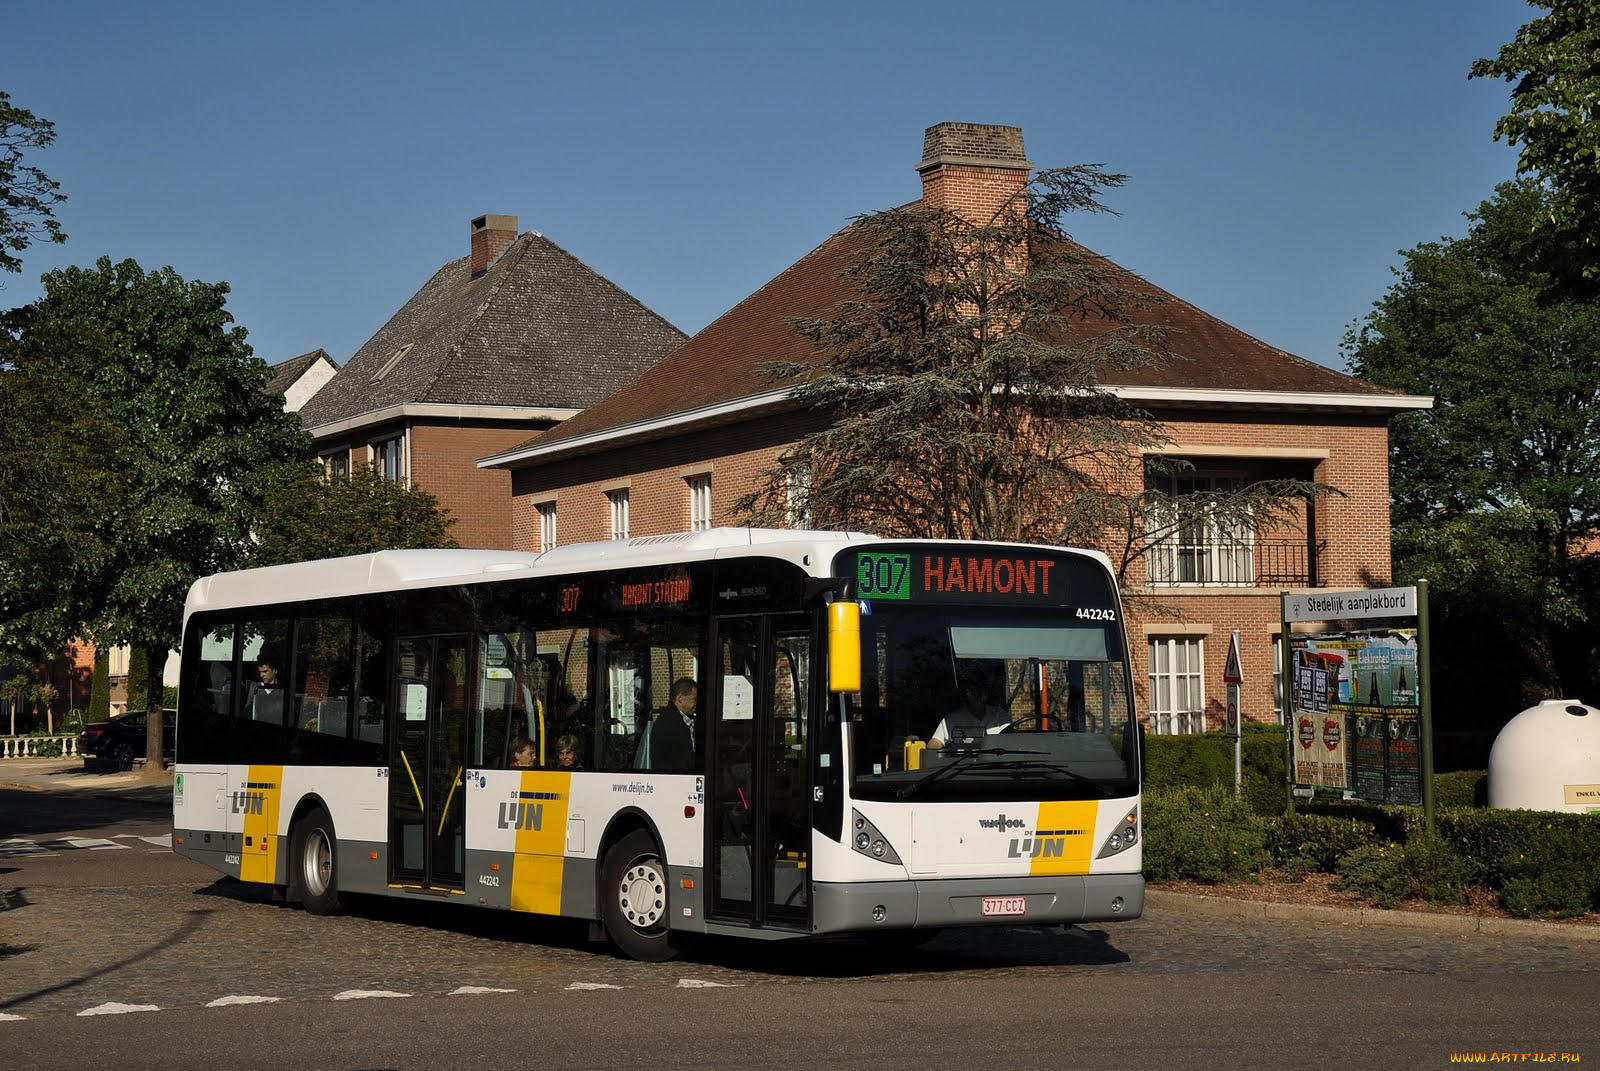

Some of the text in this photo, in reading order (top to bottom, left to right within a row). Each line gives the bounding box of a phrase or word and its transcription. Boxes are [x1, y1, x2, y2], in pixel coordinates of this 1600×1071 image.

[860, 555, 1055, 595] 307 HAMONT
[561, 587, 580, 612] 307
[622, 583, 653, 606] HAMONT
[1307, 593, 1406, 615] Stedelijk aanplakbord
[1075, 608, 1116, 621] 442242
[510, 791, 518, 799] DE
[612, 782, 654, 795] www.delijn.be
[497, 802, 544, 831] LIJN
[1008, 838, 1065, 859] LIJN
[479, 874, 499, 887] 442242
[984, 899, 1024, 913] 377-CCZ
